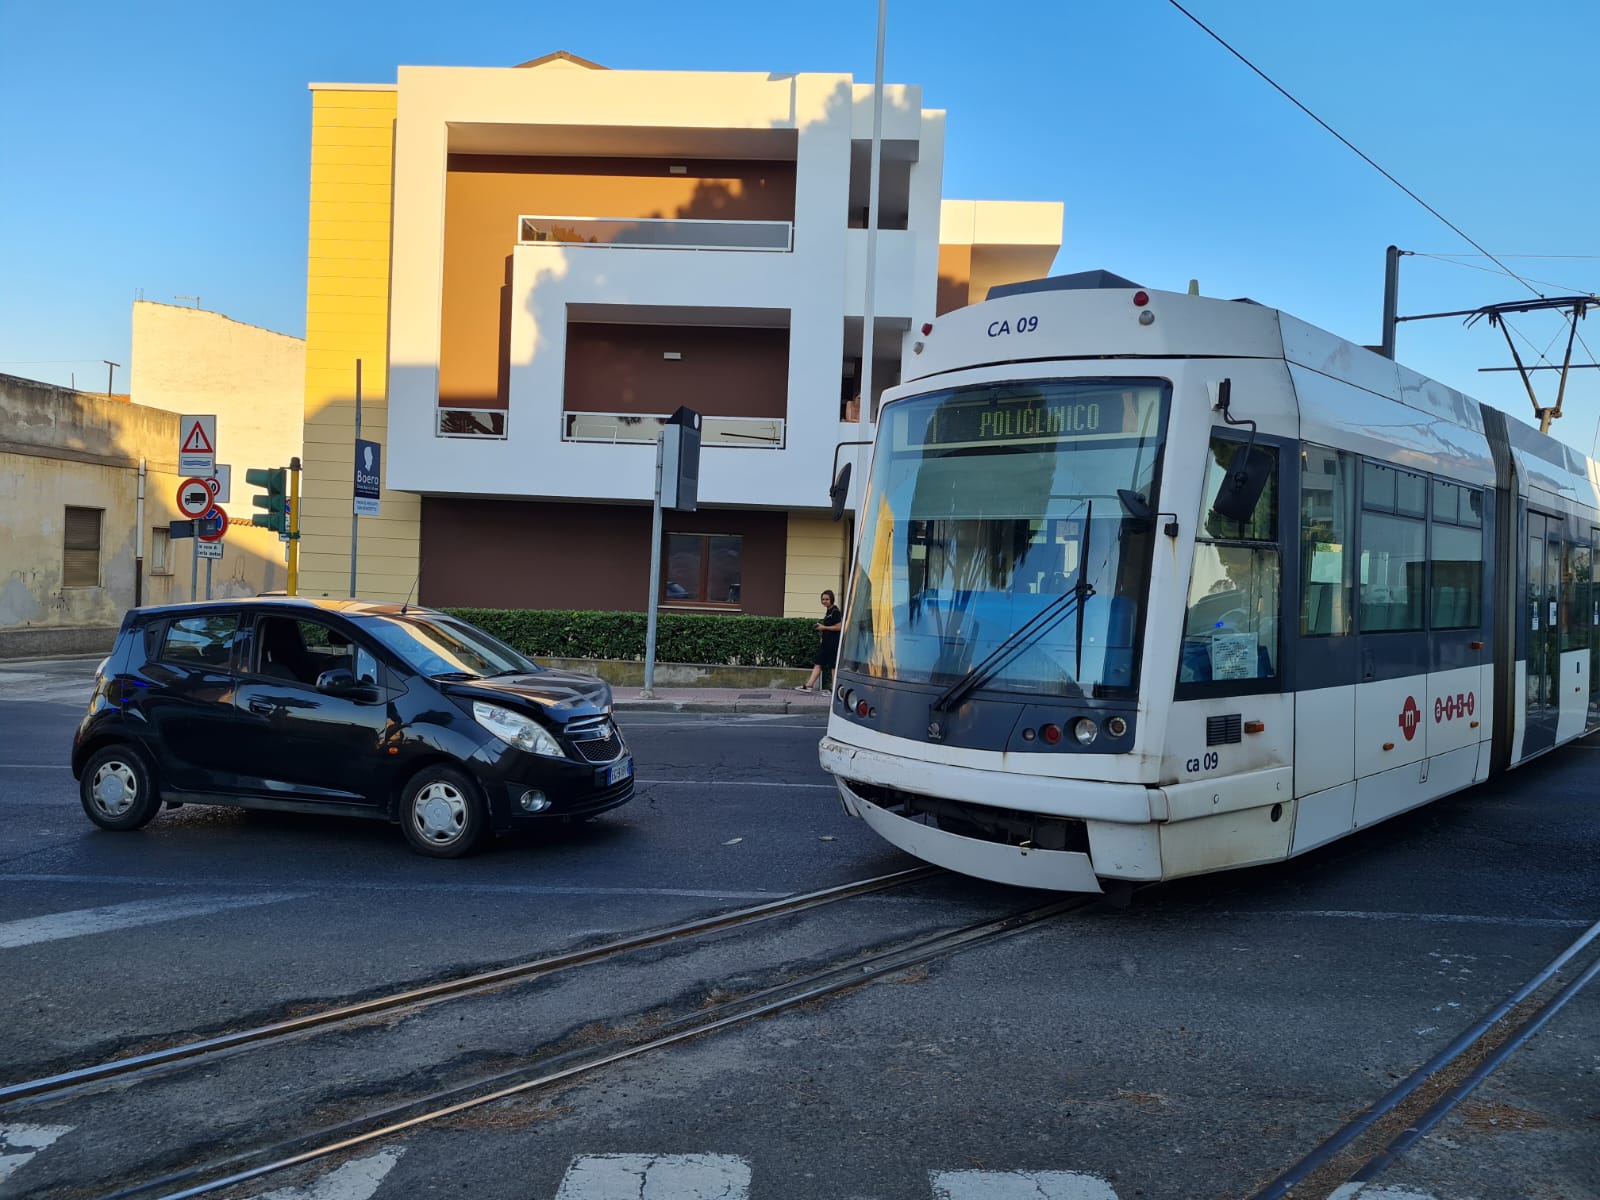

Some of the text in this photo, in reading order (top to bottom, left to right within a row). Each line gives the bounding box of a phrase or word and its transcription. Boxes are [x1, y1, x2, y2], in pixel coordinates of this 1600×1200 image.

[987, 316, 1038, 337] CA 09
[979, 403, 1099, 437] POLICLINICO
[357, 470, 379, 485] Boero
[1186, 752, 1218, 773] ca 09
